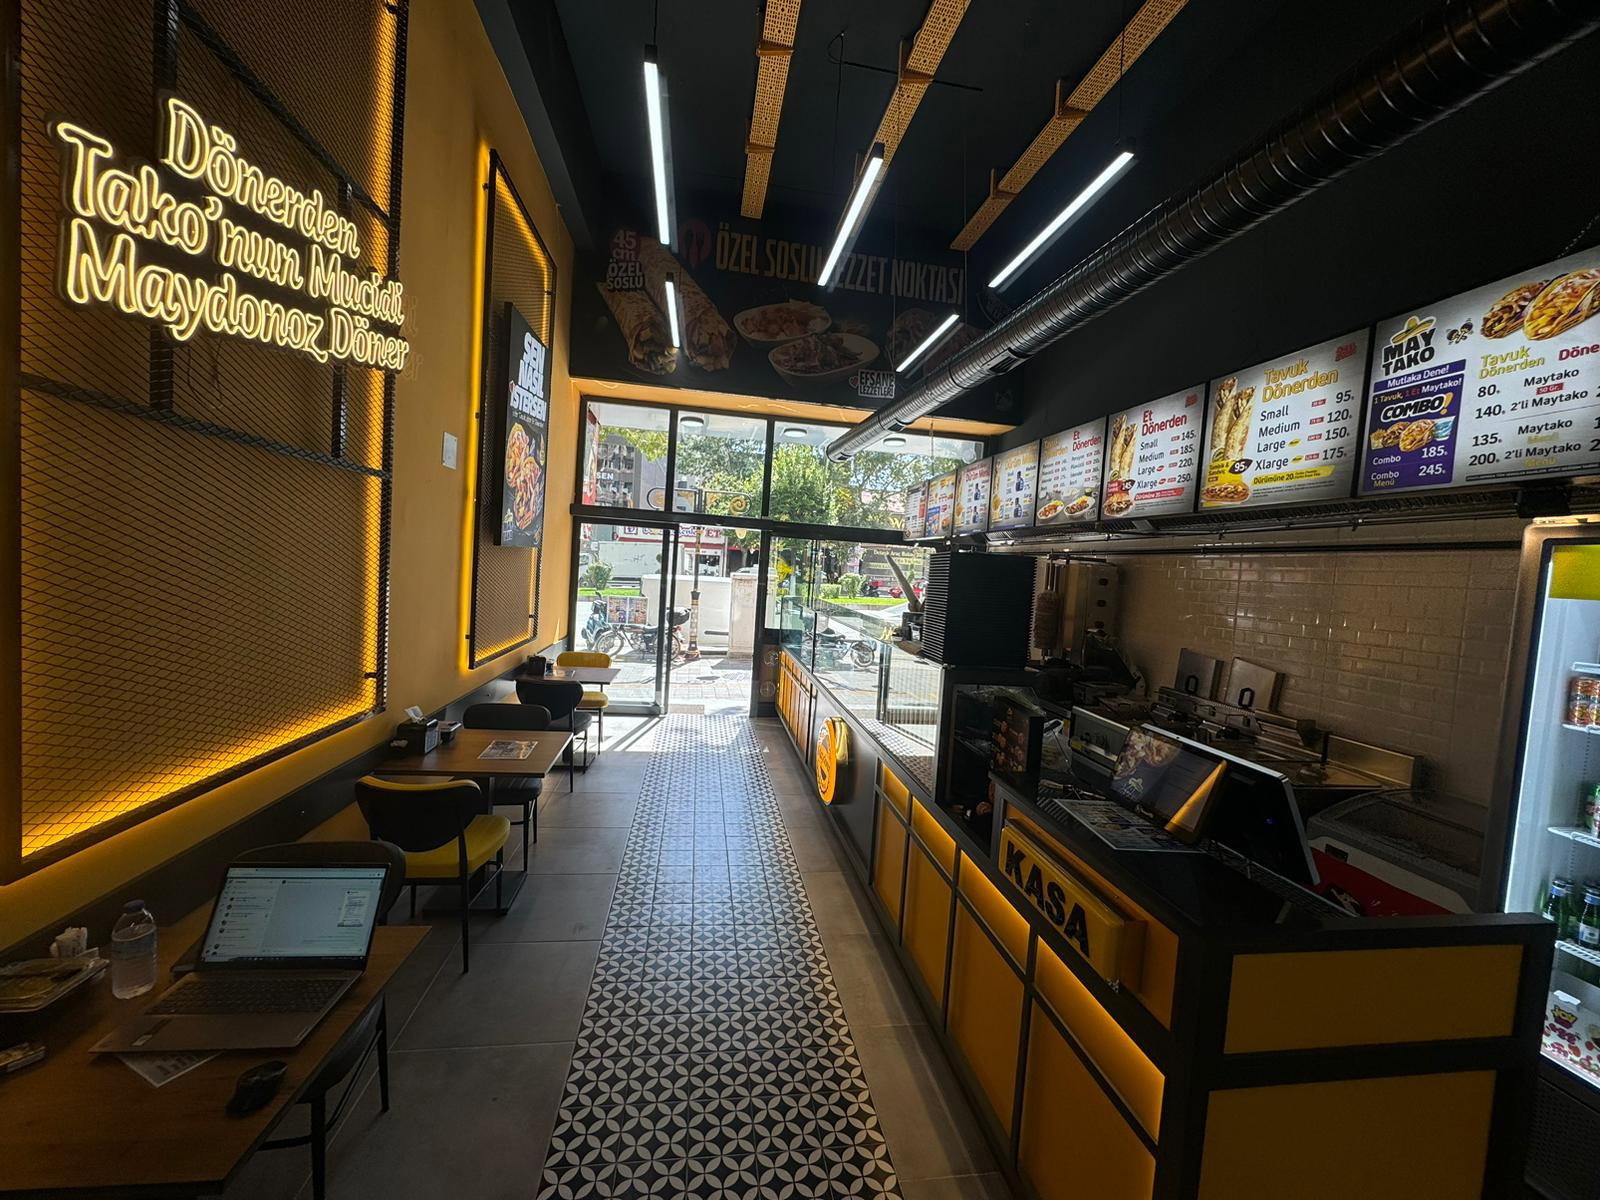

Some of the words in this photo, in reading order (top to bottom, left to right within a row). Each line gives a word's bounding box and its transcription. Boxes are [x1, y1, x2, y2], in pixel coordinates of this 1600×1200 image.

[161, 98, 360, 259] Dönerden
[57, 122, 304, 290] Tako'nun
[309, 244, 405, 326] Mucidi
[716, 222, 760, 275] ÖZEL
[835, 251, 888, 294] EZZET
[890, 258, 964, 304] NOKTASI
[67, 218, 328, 363] Maydonoz
[330, 308, 409, 370] Döner
[523, 332, 546, 375] SEN
[1383, 328, 1436, 364] MAY
[1382, 347, 1436, 377] TAKO
[1481, 346, 1531, 367] Tavuk
[1264, 358, 1310, 385] Tavuk
[1387, 372, 1422, 388] Mutlaka
[1423, 365, 1450, 379] Dene!
[1479, 356, 1545, 379] Dönerden
[1262, 369, 1339, 403] Dönerden
[1421, 378, 1462, 393] Maytako!
[1523, 368, 1579, 387] Maytako
[1510, 400, 1528, 412] 2'li
[1531, 388, 1588, 408] Maytako
[1143, 409, 1153, 423] Et
[1260, 405, 1289, 422] Small
[1142, 414, 1187, 436] Dönerden
[1258, 420, 1300, 438] Medium
[1517, 418, 1573, 437] Maytako
[1073, 435, 1102, 451] Dönerden
[1140, 439, 1158, 451] Small
[1257, 439, 1286, 453] Large
[1504, 448, 1522, 460] 2'li
[1525, 440, 1581, 459] Maytako
[1139, 451, 1164, 464] Medium
[1255, 456, 1289, 471] Xlarge
[1372, 455, 1401, 466] Combo
[1138, 465, 1155, 476] Large
[1371, 471, 1400, 481] Combo
[1136, 478, 1157, 489] Xlarge
[1374, 479, 1395, 488] Menü
[1005, 840, 1090, 958] KASA
